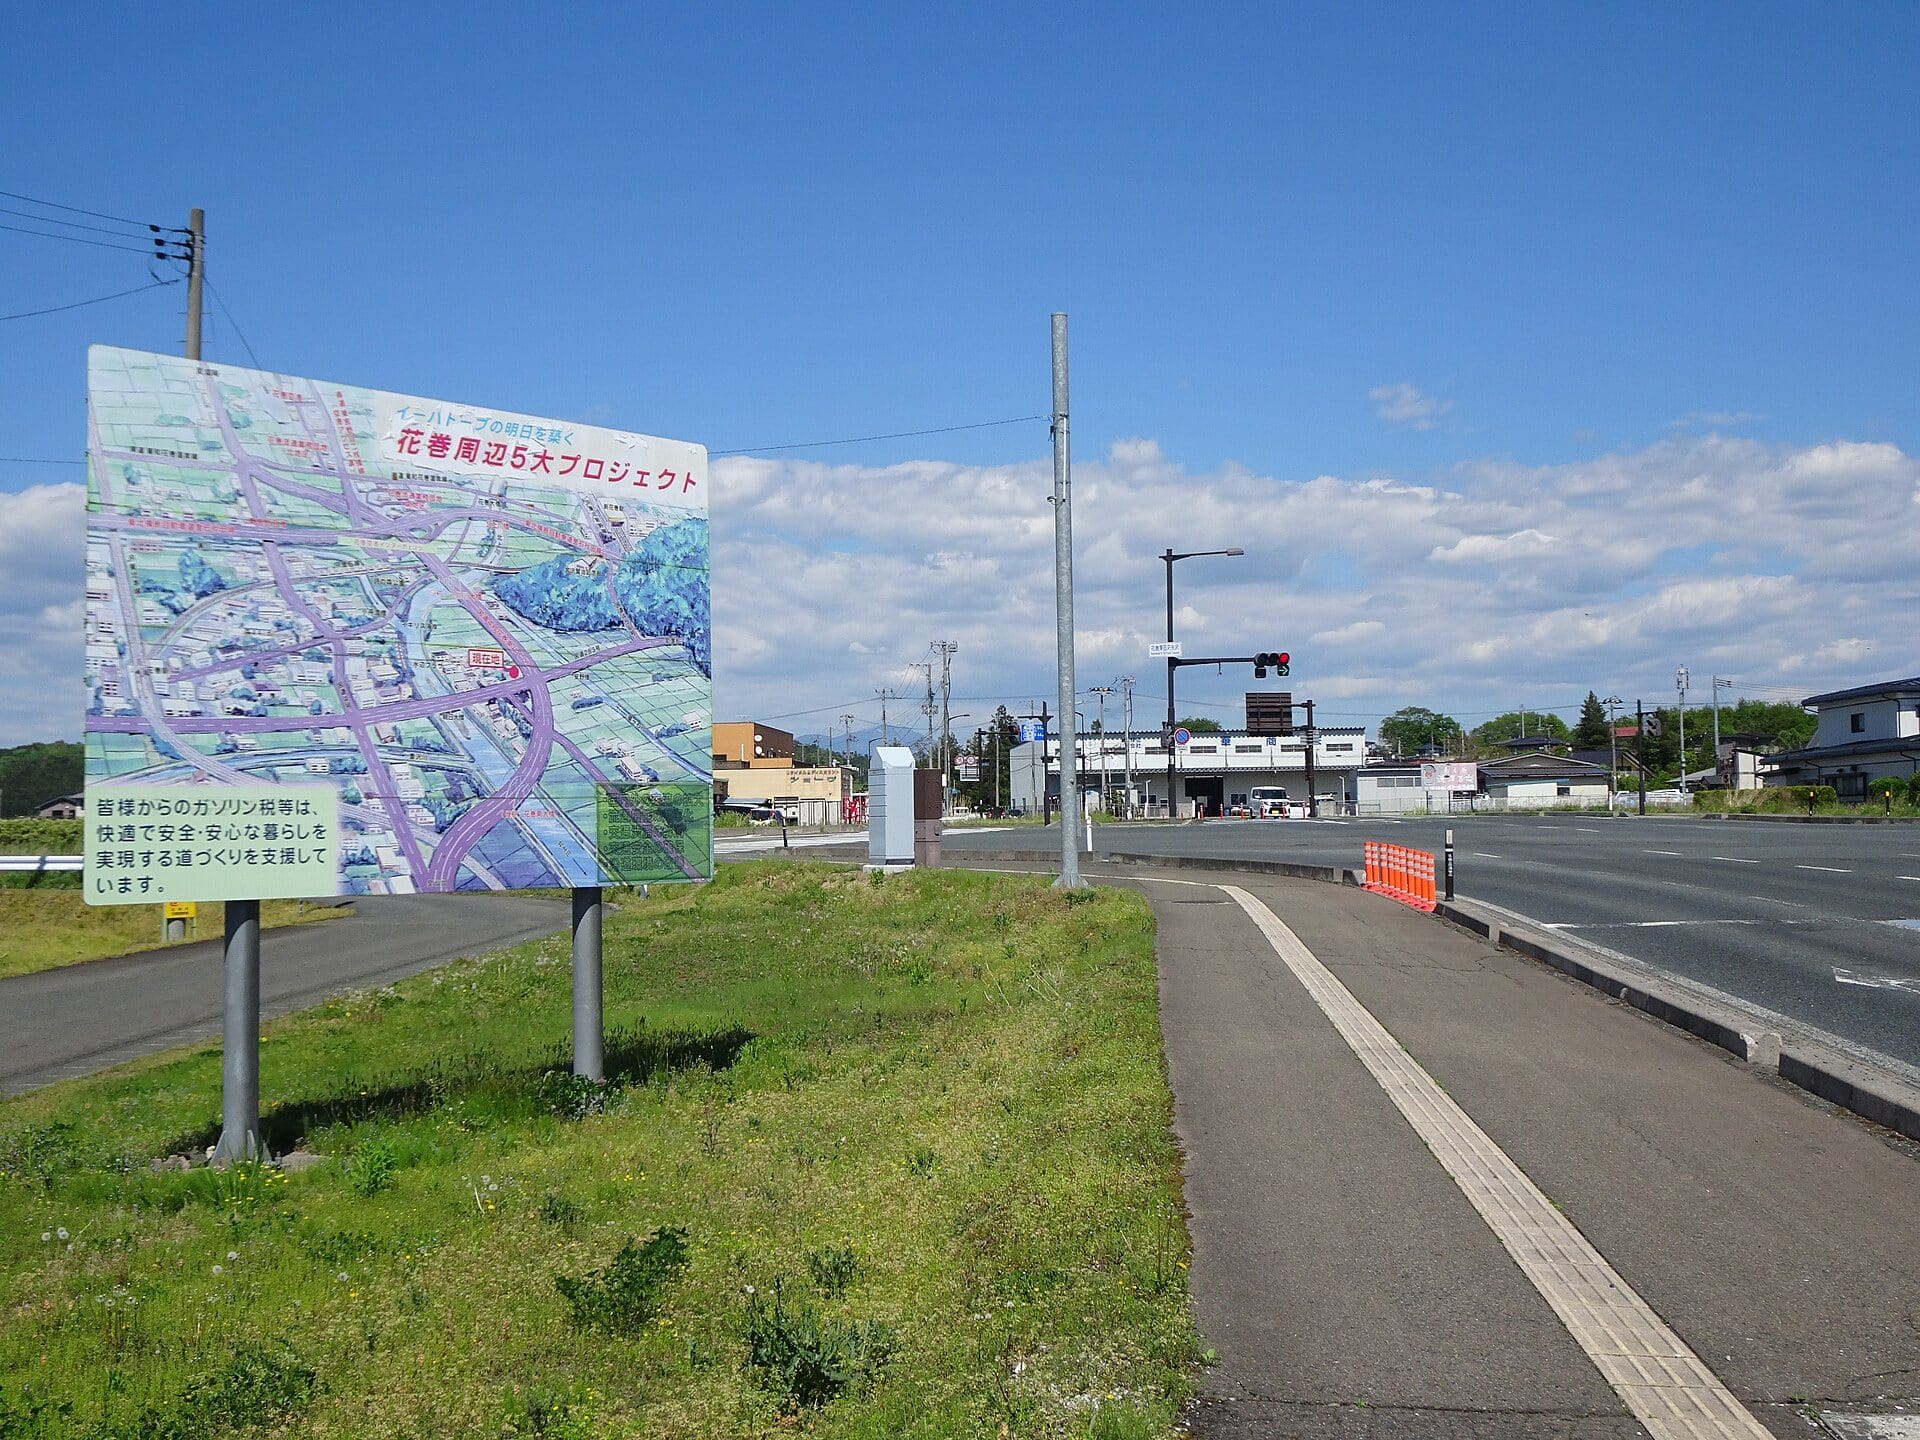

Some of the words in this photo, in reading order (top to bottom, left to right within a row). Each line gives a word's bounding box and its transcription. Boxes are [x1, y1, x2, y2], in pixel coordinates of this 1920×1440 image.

[397, 405, 575, 446] イーハトーブの明日を築く
[397, 427, 698, 494] 花巻周辺5大プロジェクト
[472, 651, 500, 666] 現在地
[97, 799, 320, 817] 皆様からのガソリン税等は、
[97, 823, 327, 843] 快適で安全・安心な暮らしを
[96, 847, 327, 868] 実現する道づくりを支援して
[96, 875, 165, 894] います。
